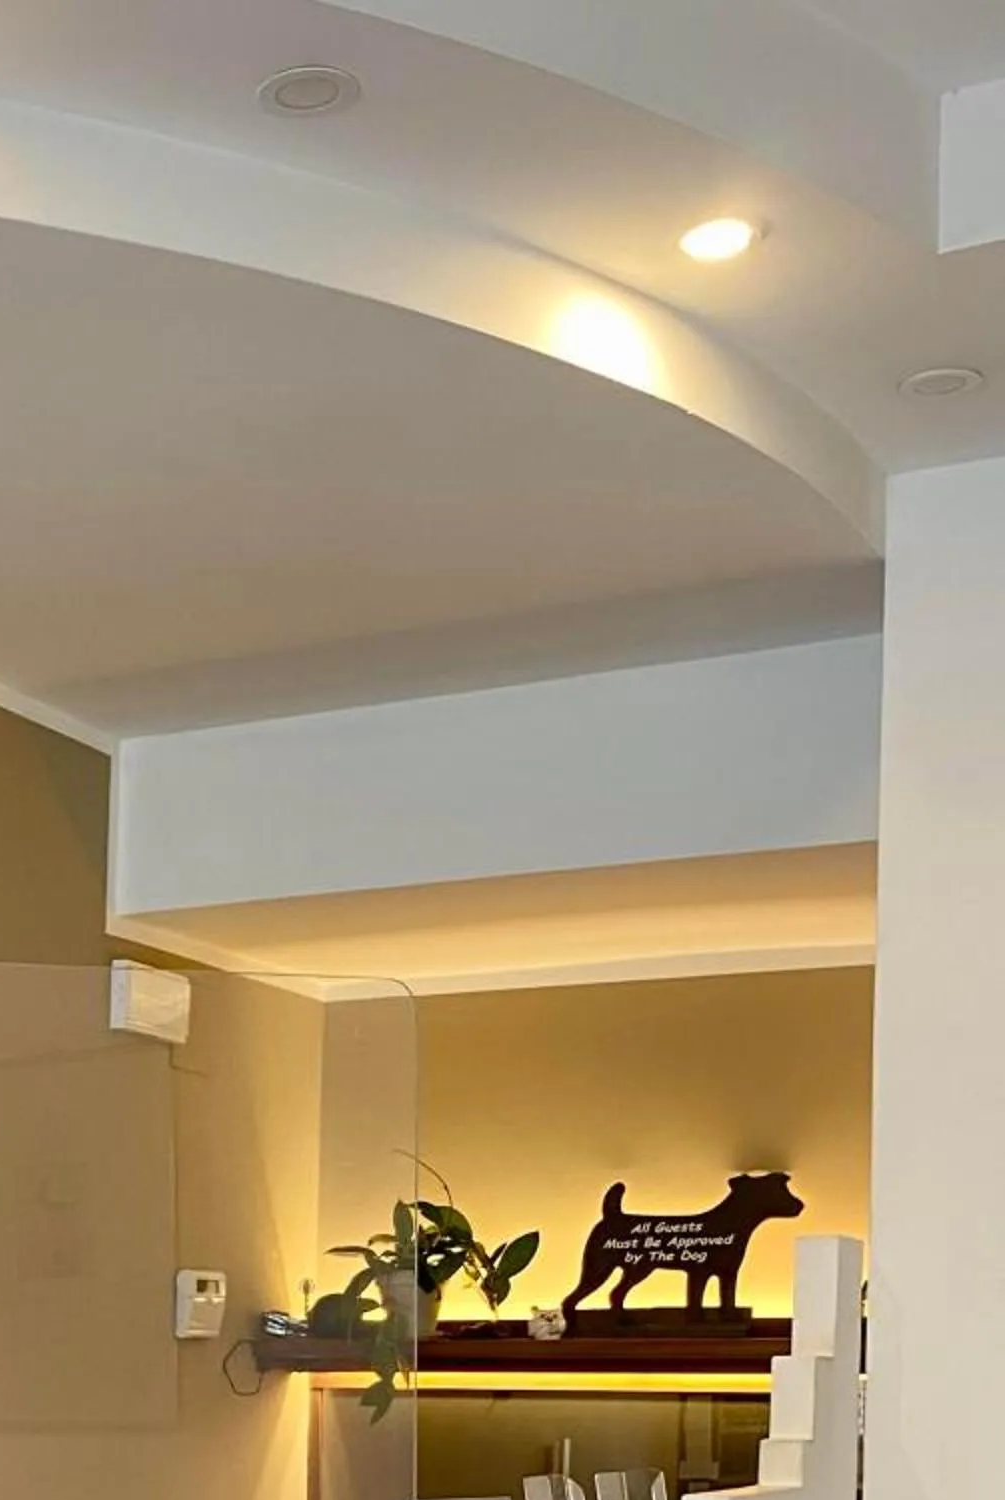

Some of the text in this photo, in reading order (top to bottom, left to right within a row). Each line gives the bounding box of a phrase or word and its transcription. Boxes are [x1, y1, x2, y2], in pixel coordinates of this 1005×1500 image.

[631, 1221, 704, 1234] All Guests
[603, 1234, 734, 1249] Must Be Approved
[624, 1249, 708, 1264] by The Dog
